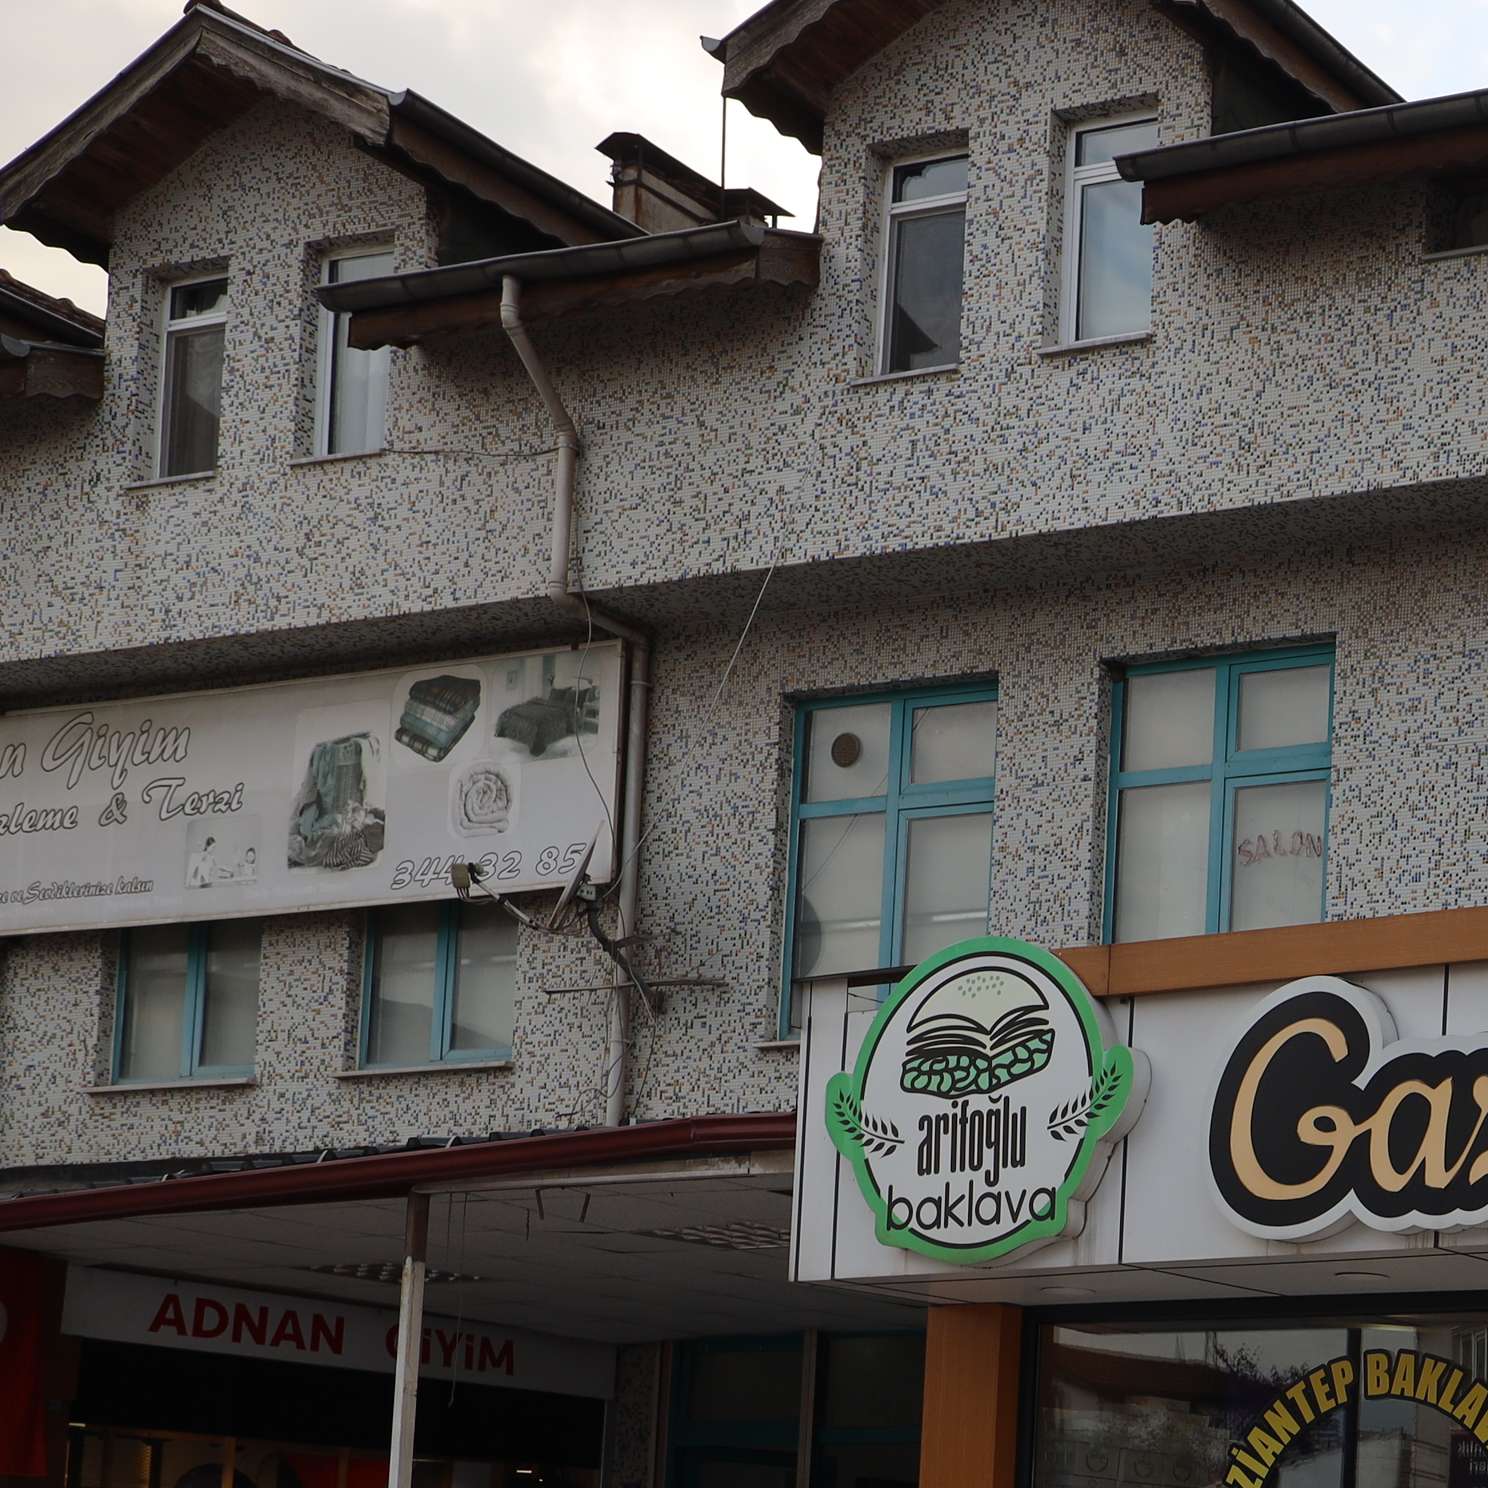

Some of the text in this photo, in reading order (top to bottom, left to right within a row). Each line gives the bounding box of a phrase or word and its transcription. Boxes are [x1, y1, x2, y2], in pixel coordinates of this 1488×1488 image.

[40, 711, 191, 790] Giyim
[98, 792, 128, 827] &
[142, 777, 244, 821] Terzi
[536, 843, 587, 876] 85
[917, 1094, 1027, 1187] arifoğlu
[886, 1180, 1057, 1232] baklava
[150, 1294, 345, 1355] ADNAN
